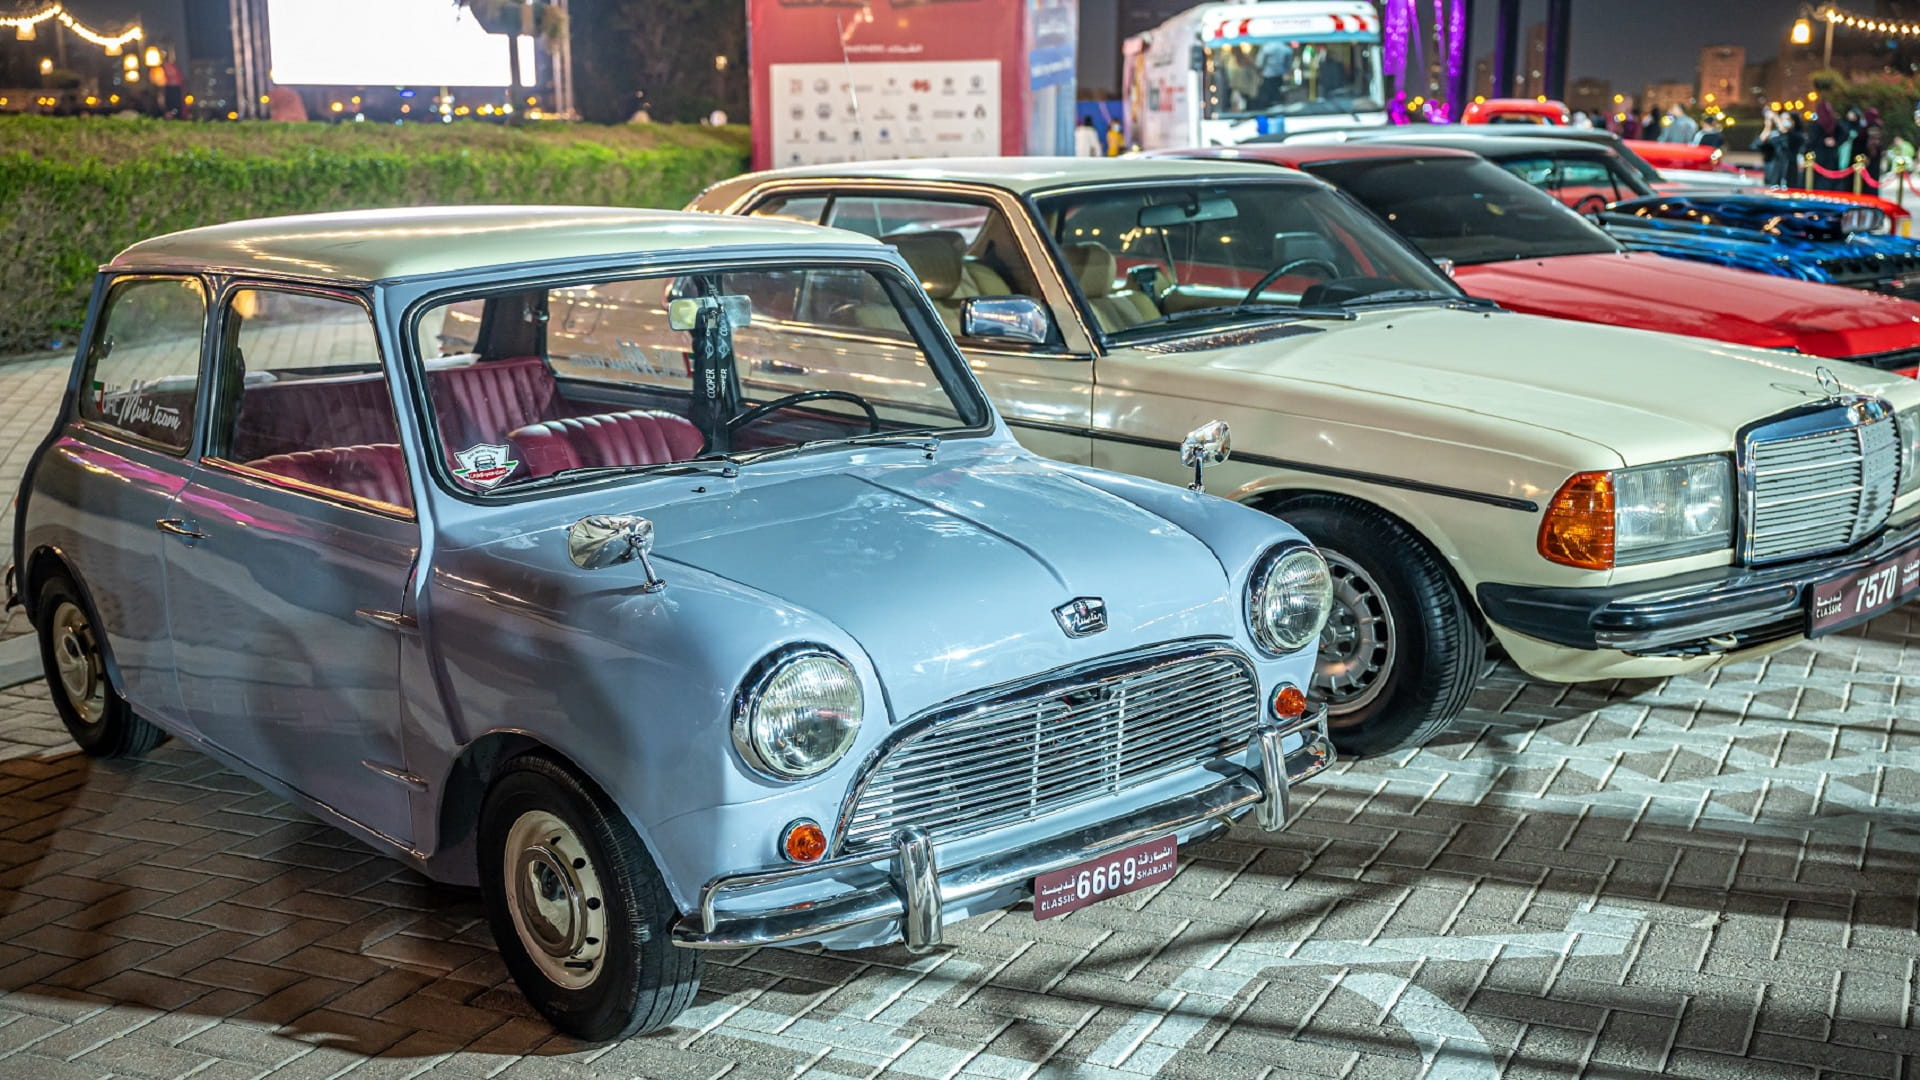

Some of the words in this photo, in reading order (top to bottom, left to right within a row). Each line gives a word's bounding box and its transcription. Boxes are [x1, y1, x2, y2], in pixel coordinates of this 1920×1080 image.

[705, 368, 716, 399] COOPER
[117, 379, 152, 425] Mini
[1856, 565, 1897, 613] 7570
[1816, 603, 1842, 618] CLASSIC
[1077, 857, 1136, 899] 6669
[1137, 861, 1173, 880] SHARJAH
[1041, 893, 1075, 911] CLASSIC
